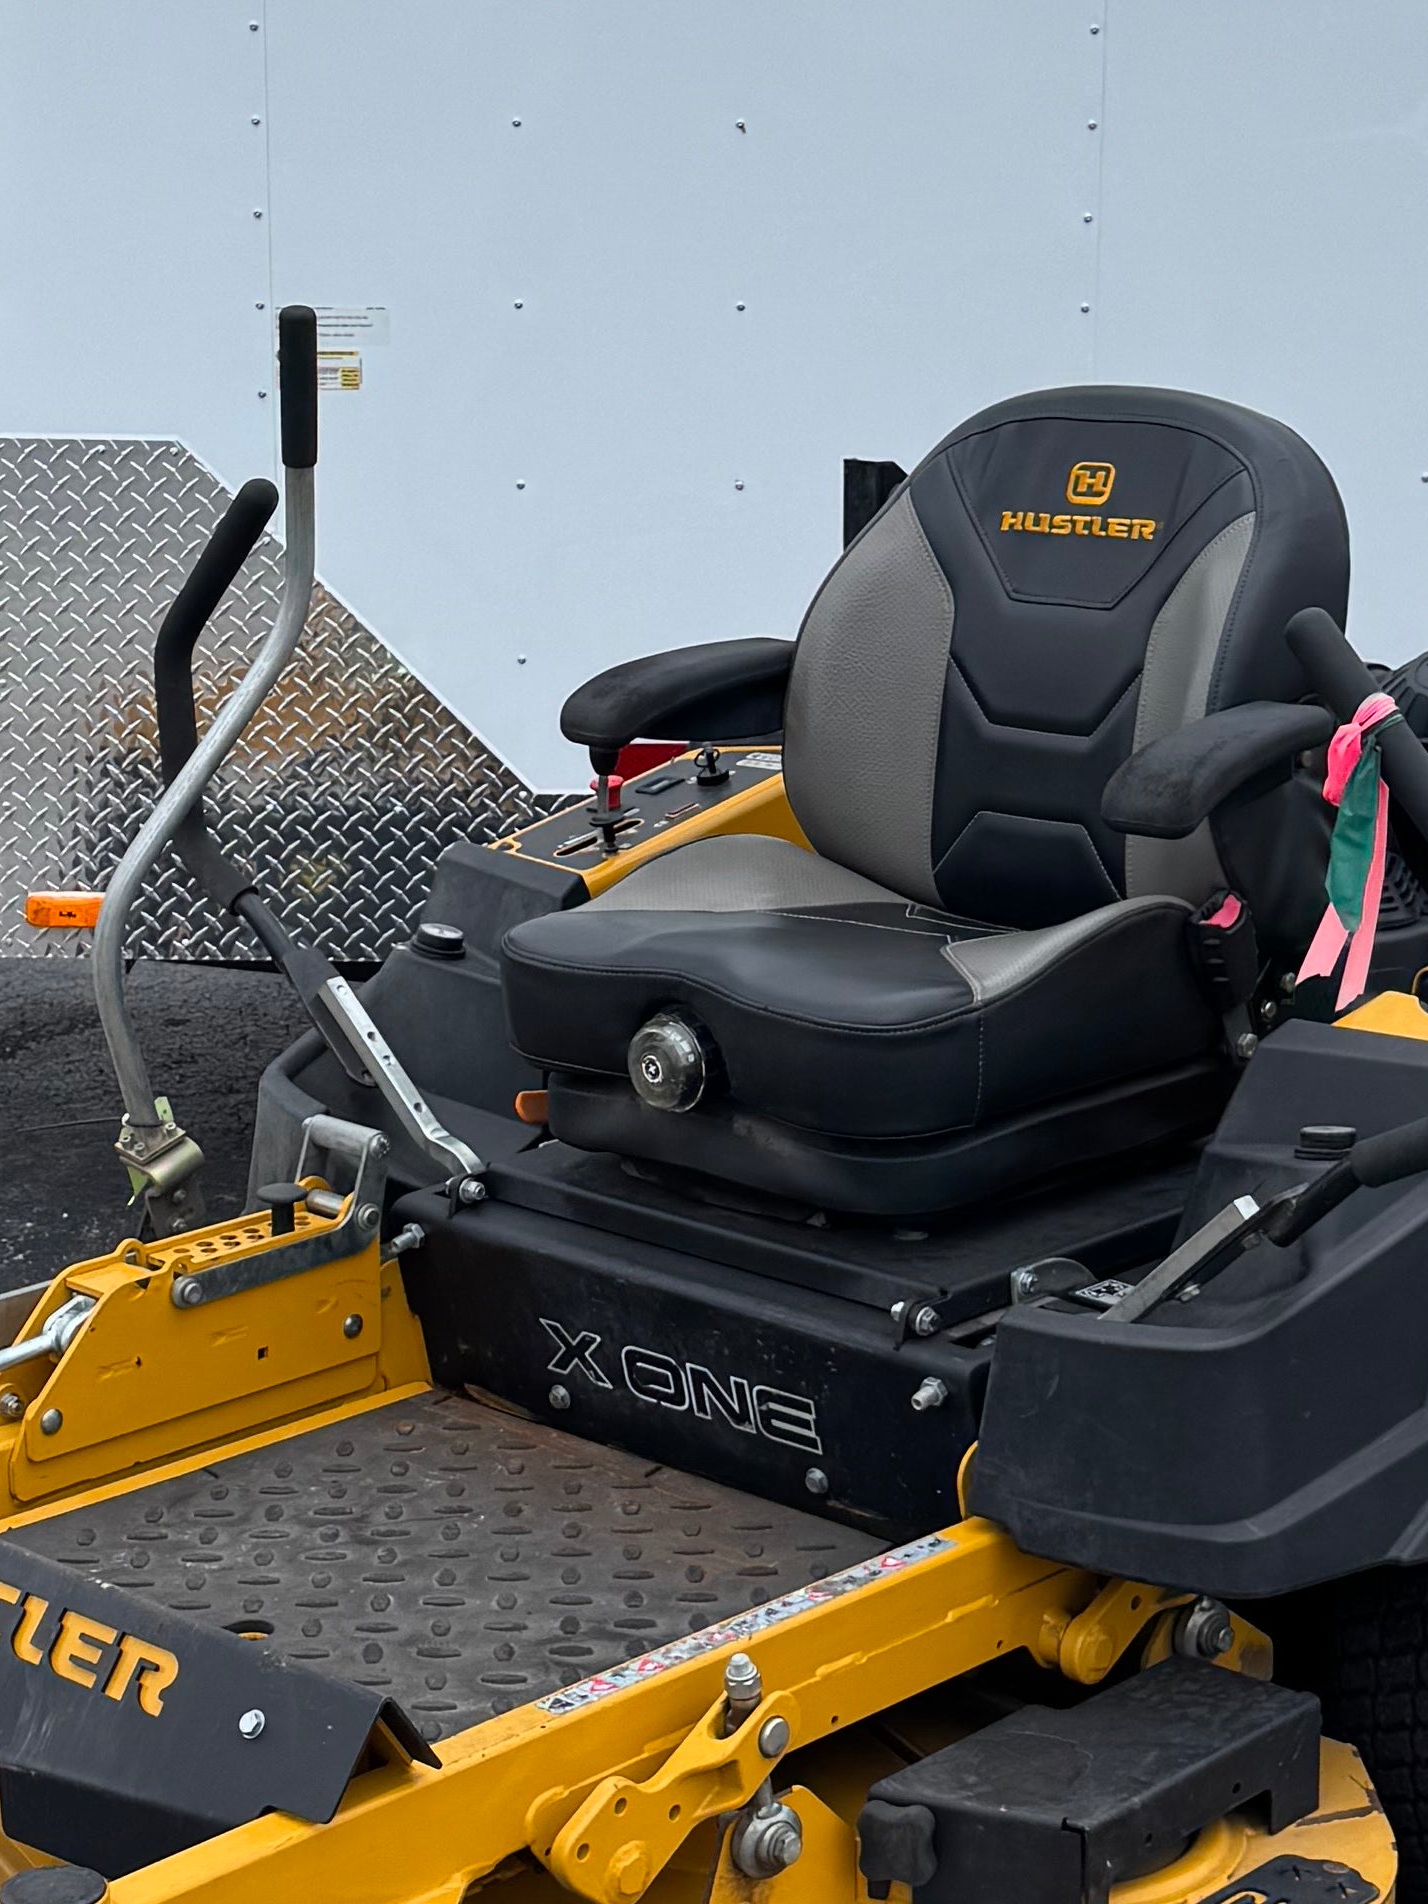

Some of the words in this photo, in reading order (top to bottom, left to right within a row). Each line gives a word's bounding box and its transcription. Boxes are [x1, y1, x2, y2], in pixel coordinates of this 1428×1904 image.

[999, 510, 1157, 541] HUSTLER
[538, 1317, 614, 1390] X
[621, 1345, 823, 1456] ONE
